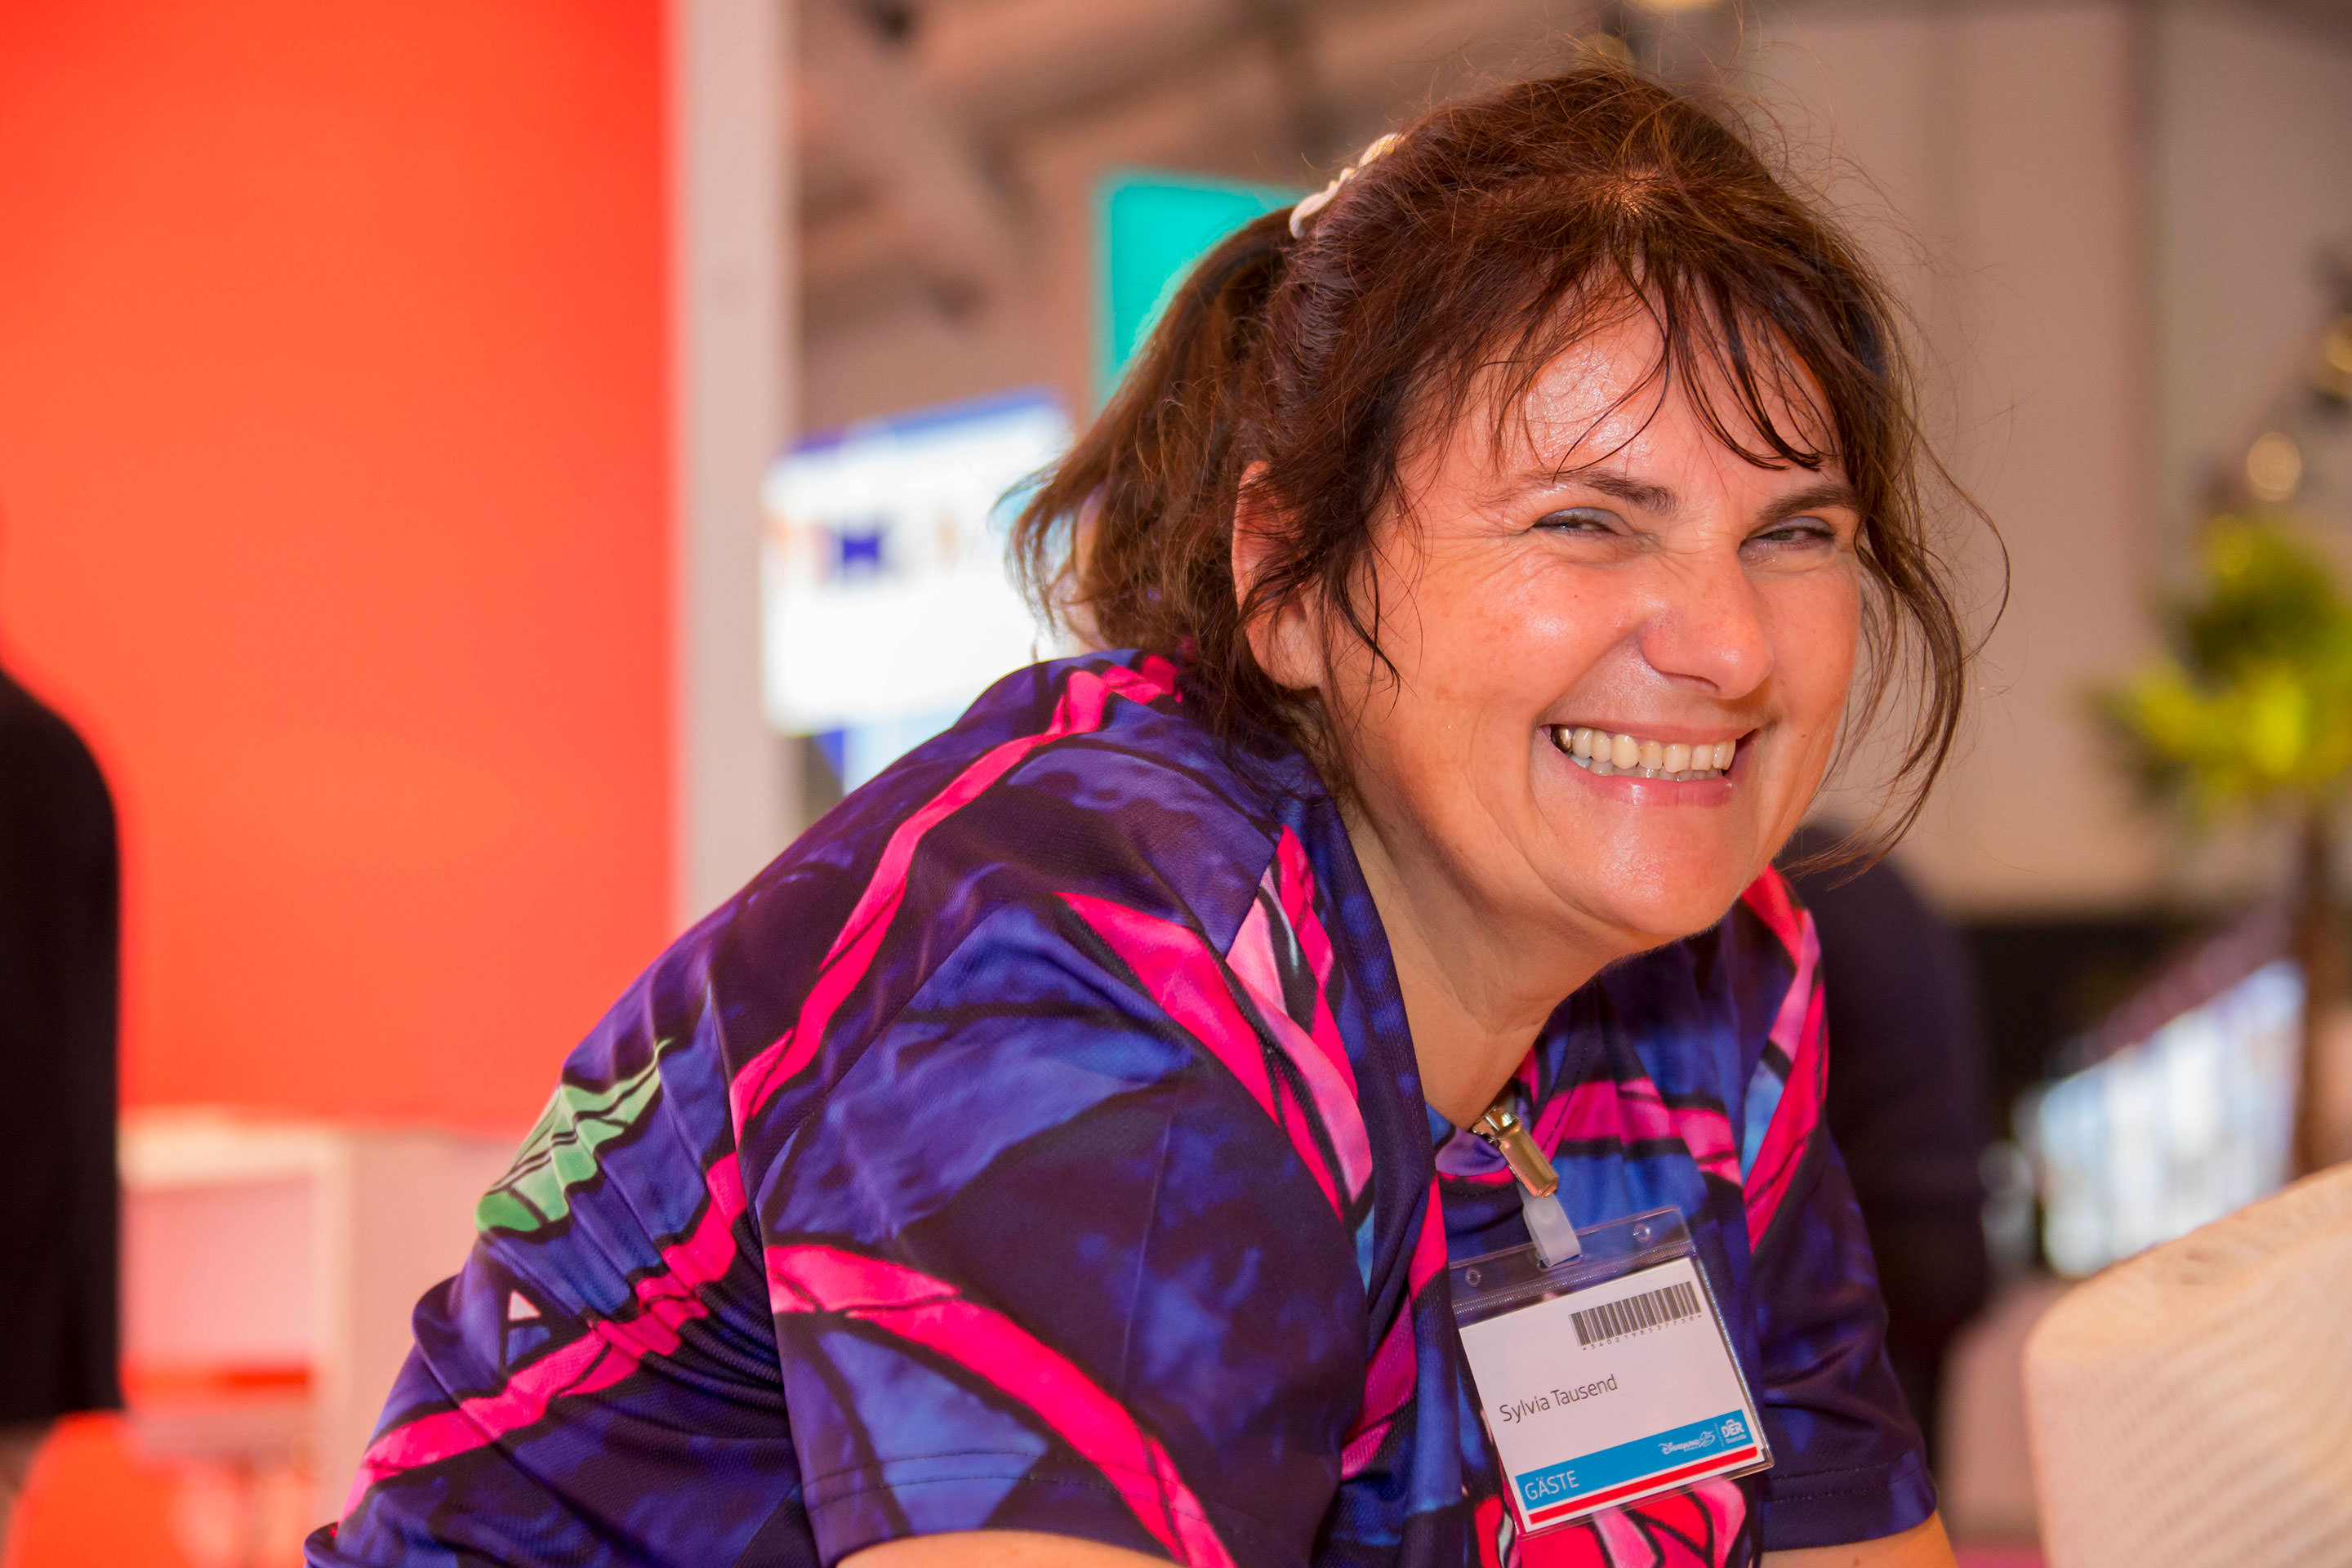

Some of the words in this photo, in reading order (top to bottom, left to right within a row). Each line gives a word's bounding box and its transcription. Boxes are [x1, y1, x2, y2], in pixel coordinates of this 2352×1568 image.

[1499, 1396, 1550, 1423] Sylvia
[1551, 1374, 1618, 1405] Tausend
[1721, 1421, 1744, 1438] DER
[1524, 1470, 1579, 1500] GÄSTE
